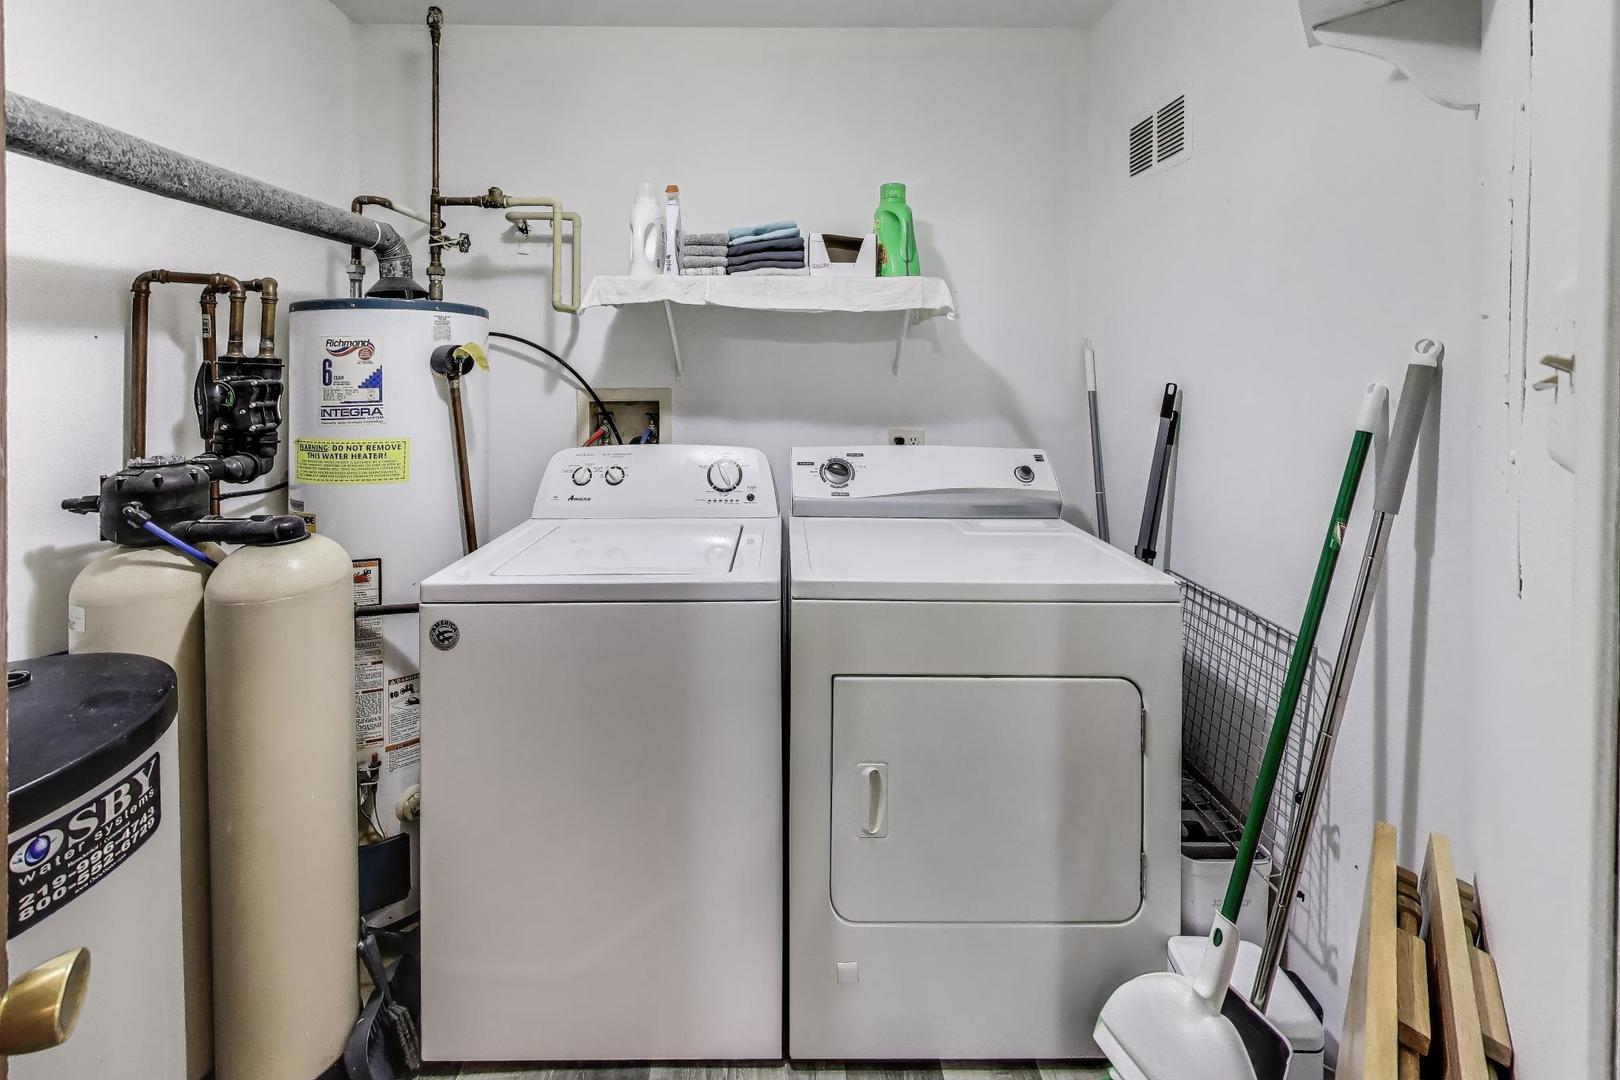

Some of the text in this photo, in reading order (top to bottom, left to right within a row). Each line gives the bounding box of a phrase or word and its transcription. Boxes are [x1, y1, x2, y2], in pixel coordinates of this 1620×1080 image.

[326, 338, 370, 347] Richmond
[322, 358, 333, 387] 6
[320, 407, 382, 417] INTEGRA
[322, 452, 348, 460] WATER
[351, 452, 387, 460] HEATER!
[332, 444, 344, 452] DO
[346, 444, 364, 452] NOT
[366, 443, 402, 452] REMOVE
[431, 619, 459, 633] AMERICA
[9, 756, 157, 875] OSBY
[19, 841, 85, 887] water
[94, 788, 155, 841] systems
[18, 805, 155, 911] 219-996-4743
[18, 816, 155, 922] 800-552-6729
